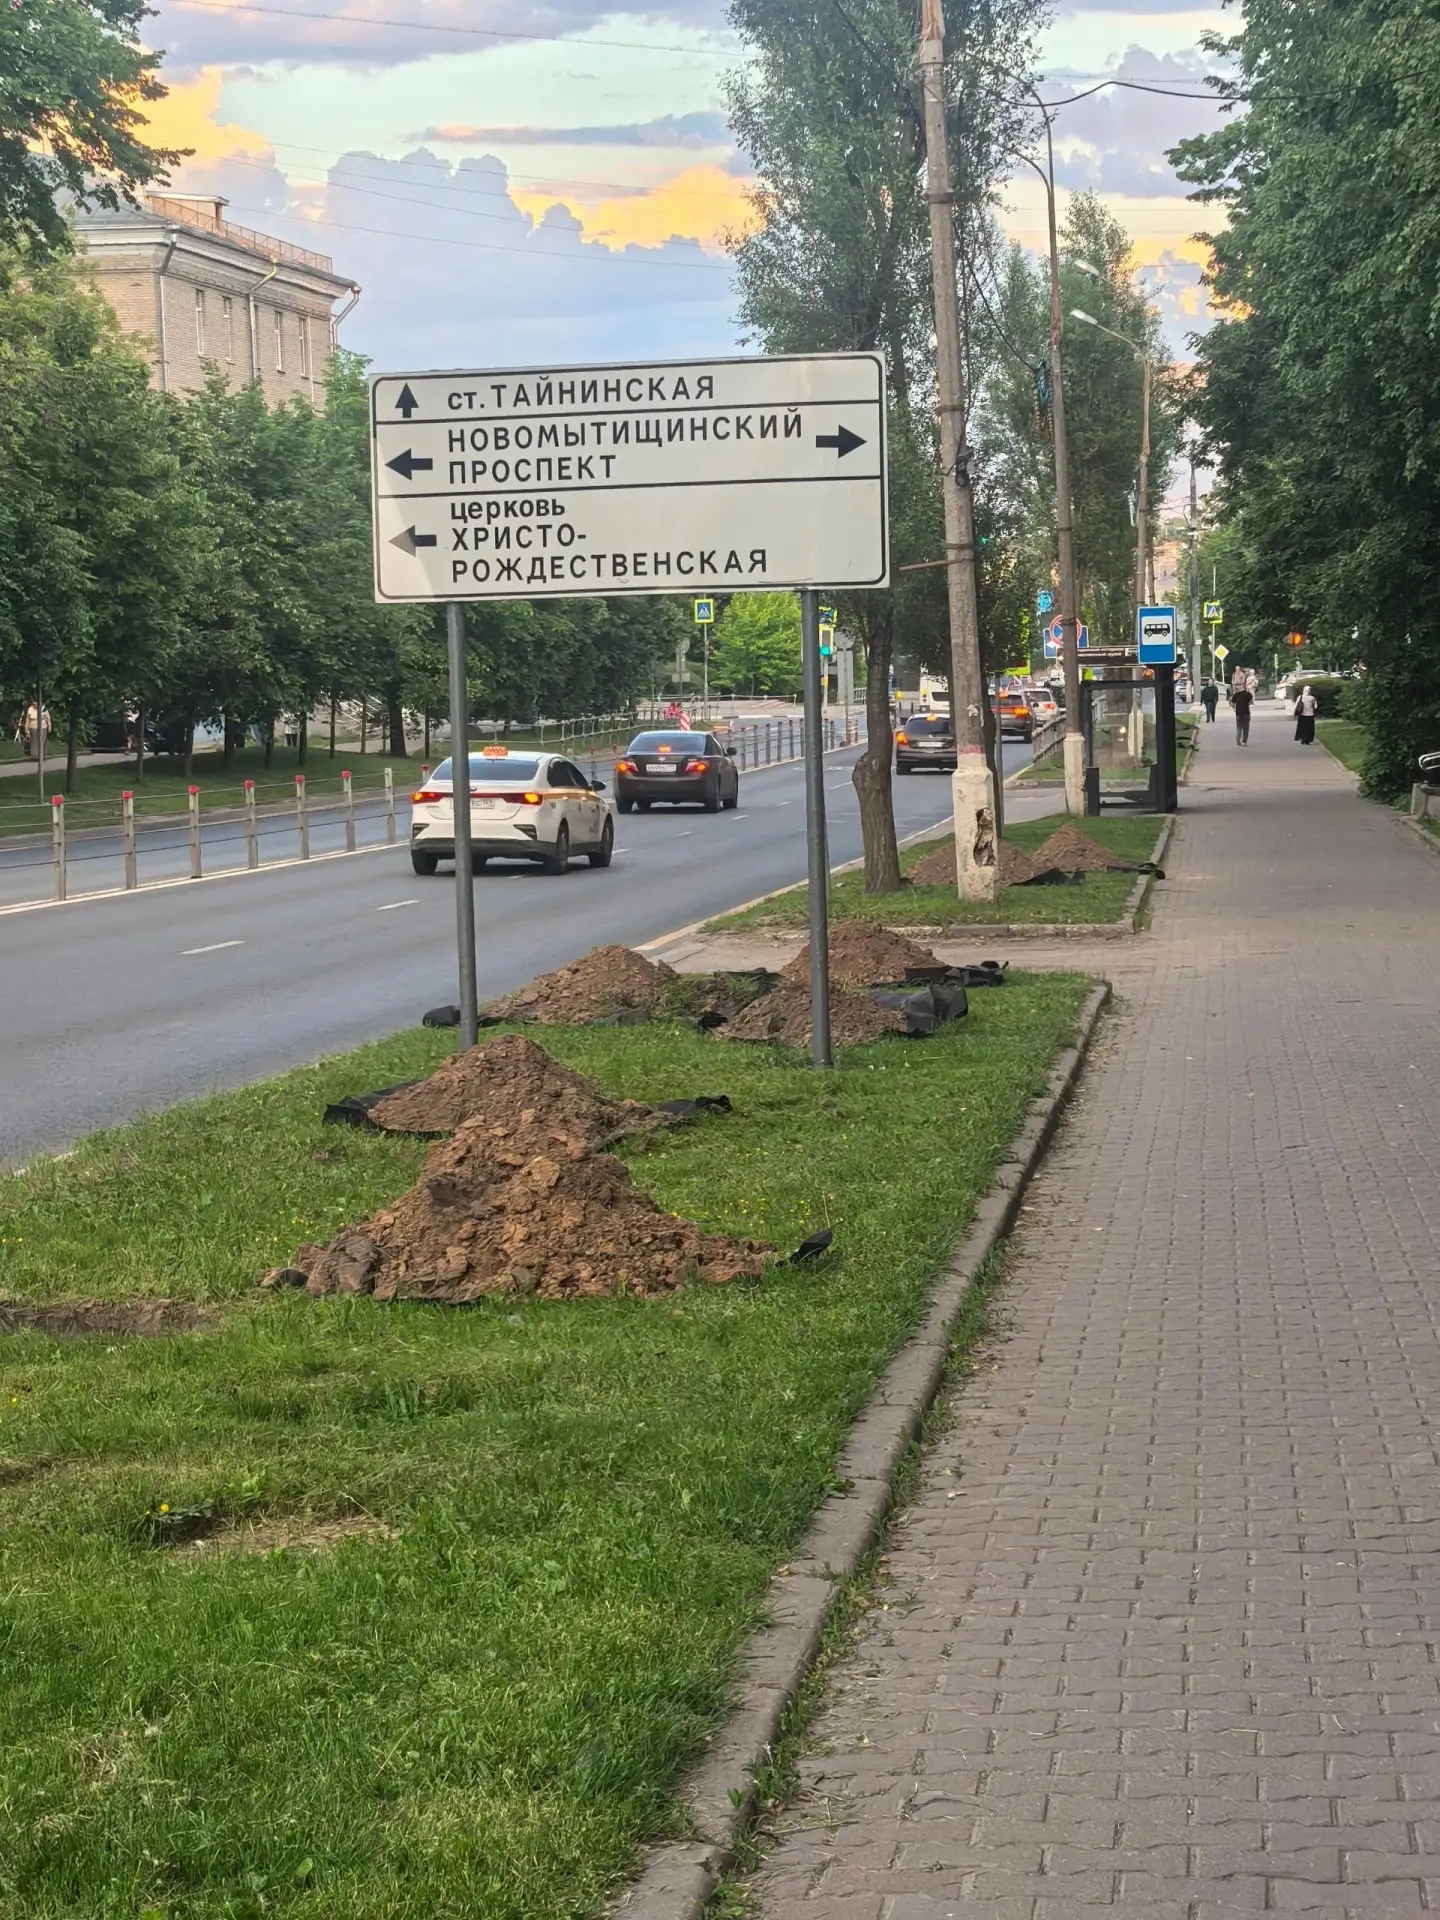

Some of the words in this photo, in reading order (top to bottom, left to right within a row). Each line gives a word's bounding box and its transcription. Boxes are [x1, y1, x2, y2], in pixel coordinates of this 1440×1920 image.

[448, 407, 802, 453] НОВОМЫТИЩИНСКИЙ
[449, 454, 616, 486] ПРОСПЕКТ
[450, 498, 566, 524] церковь
[451, 523, 588, 552] ХРИСТО-
[452, 549, 768, 585] РОЖДЕСТВЕНСКАЯ
